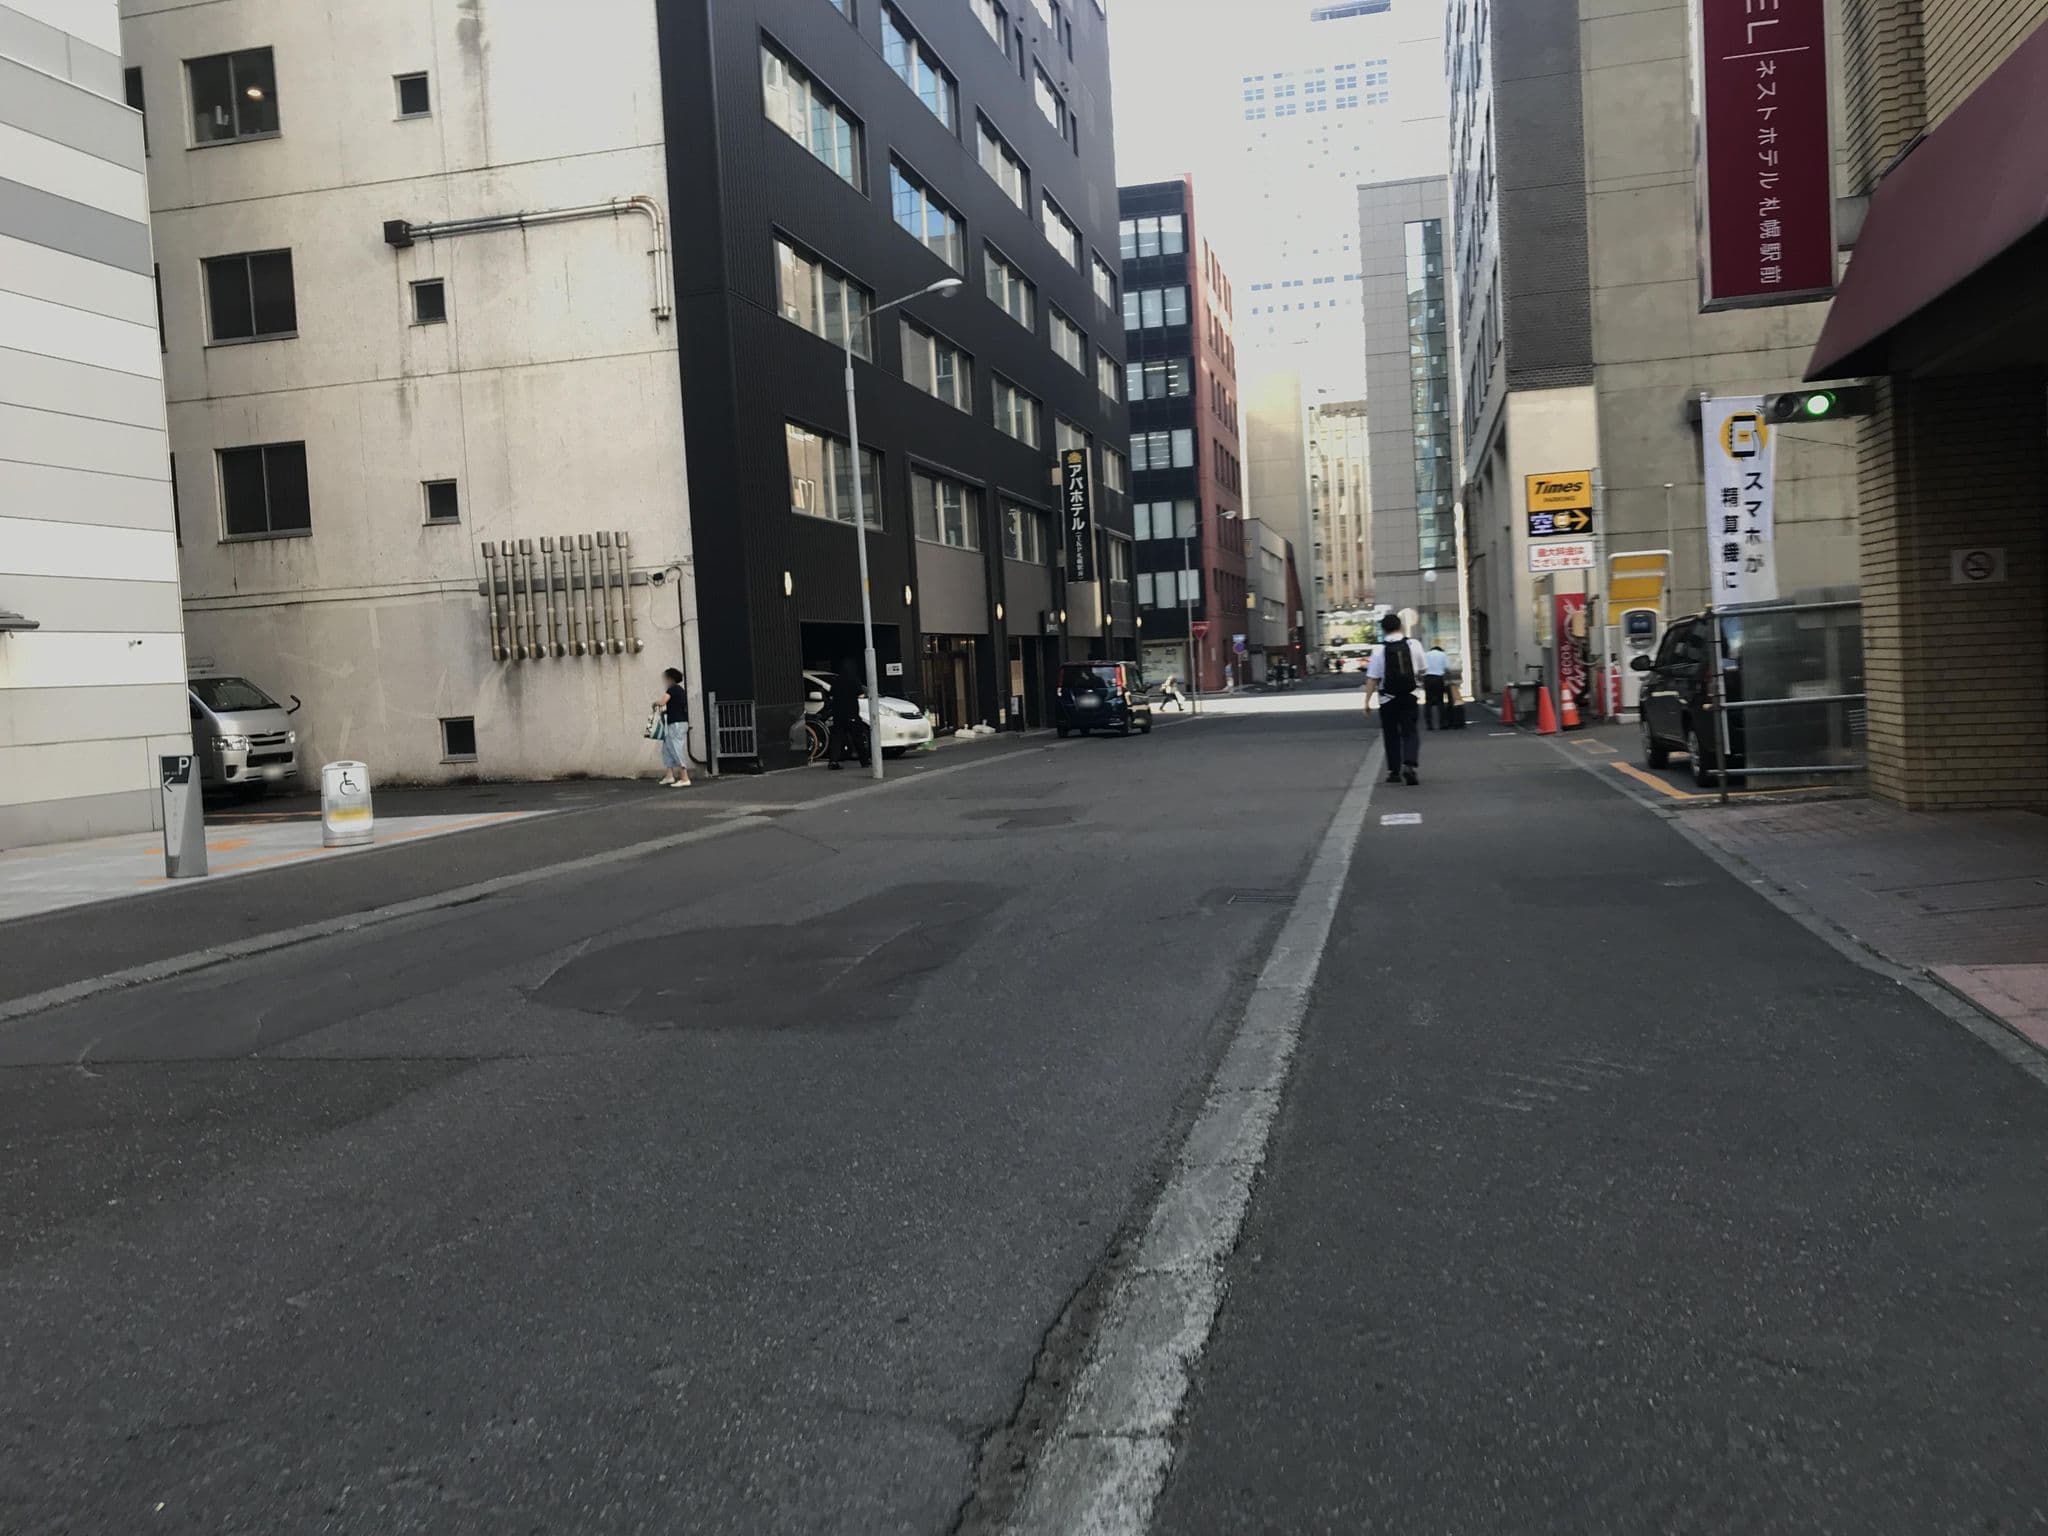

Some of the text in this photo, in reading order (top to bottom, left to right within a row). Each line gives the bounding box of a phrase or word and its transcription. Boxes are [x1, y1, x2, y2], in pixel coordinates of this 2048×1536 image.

[1068, 464, 1086, 531] アパホテル
[1535, 481, 1584, 495] Times
[1744, 472, 1765, 574] スマホが
[179, 757, 190, 776] P
